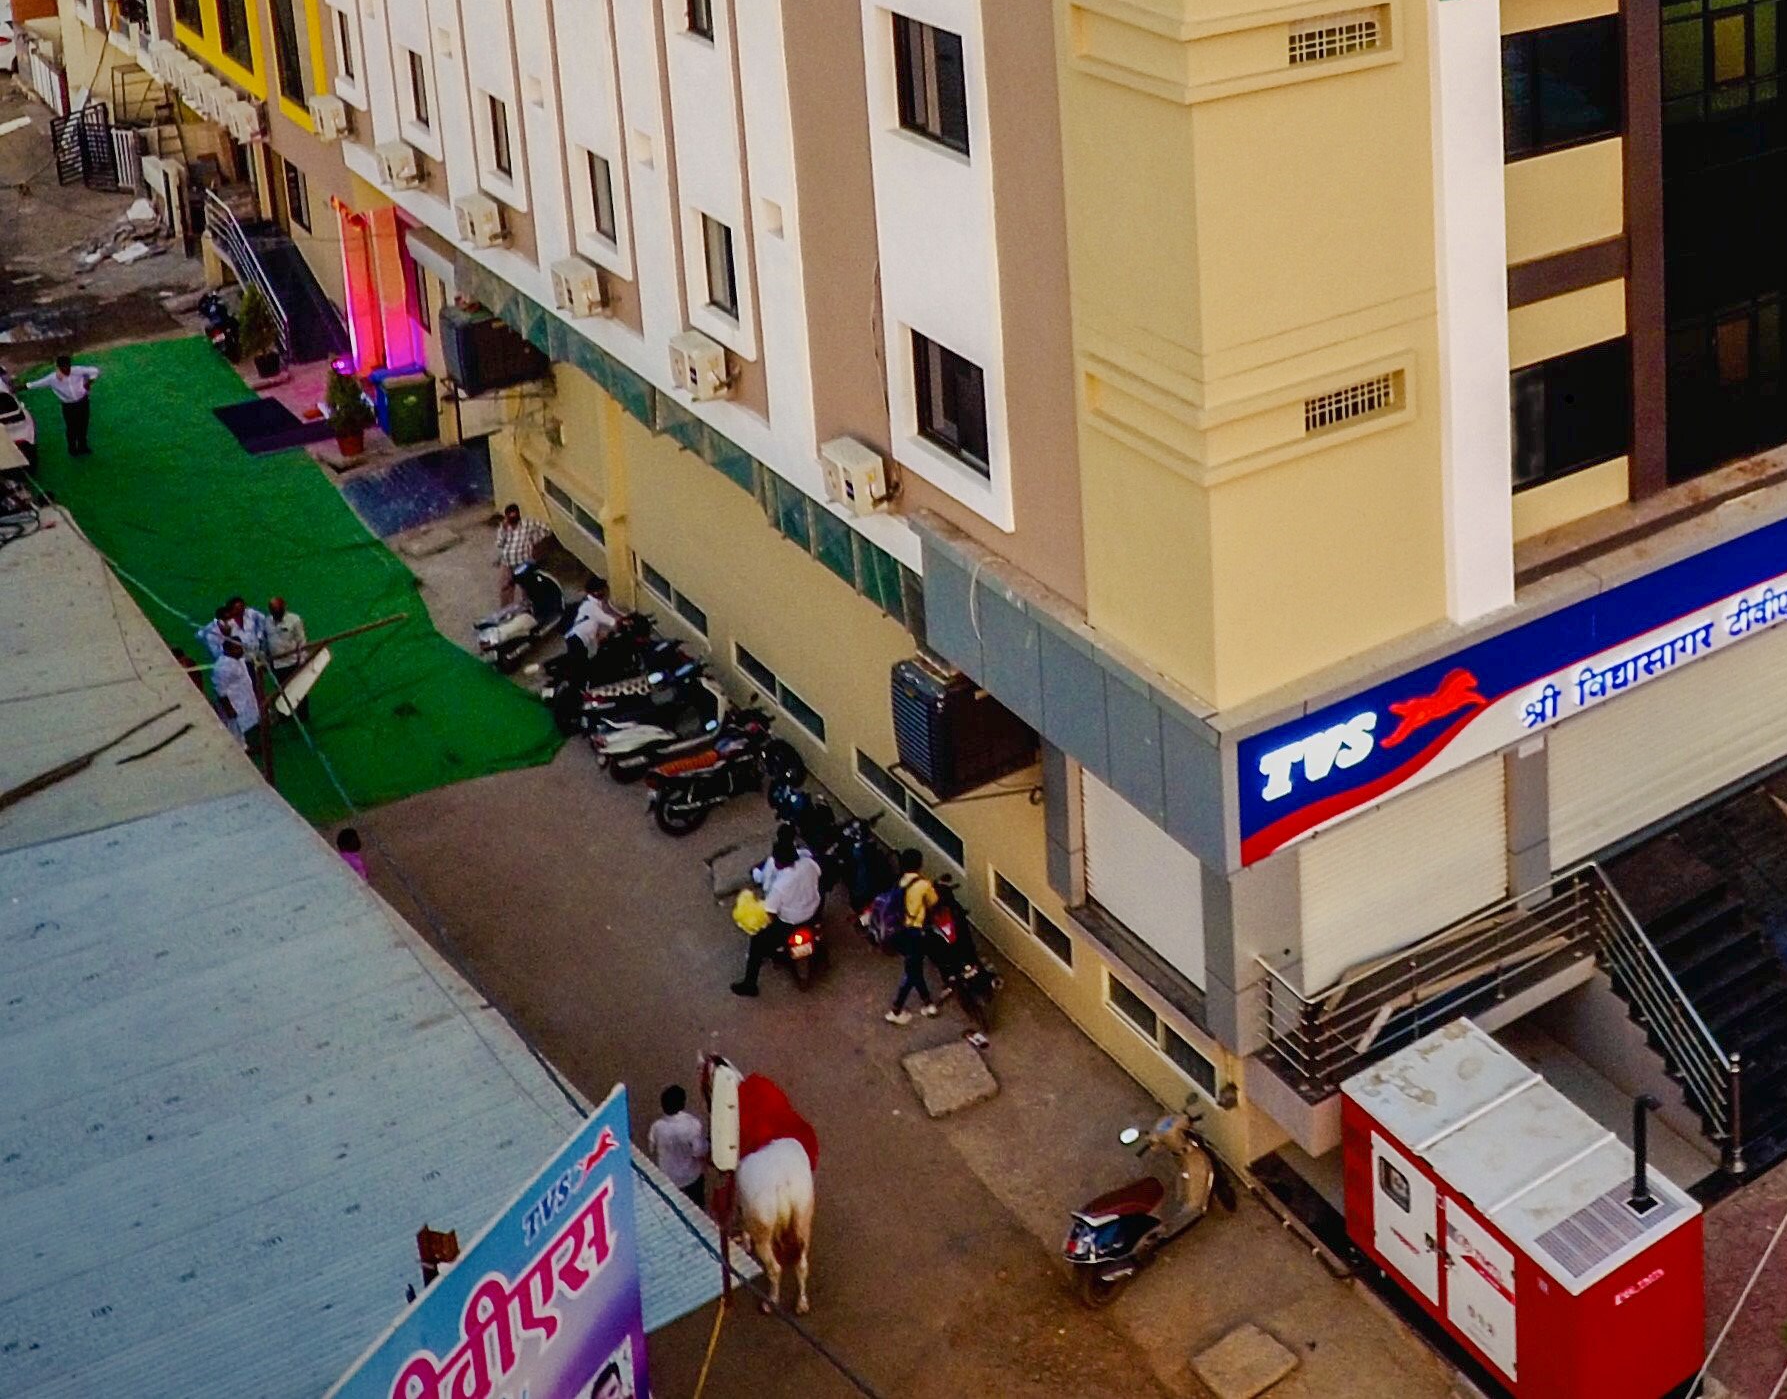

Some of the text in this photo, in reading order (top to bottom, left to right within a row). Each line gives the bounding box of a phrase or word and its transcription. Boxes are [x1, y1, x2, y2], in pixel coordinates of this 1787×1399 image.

[1521, 684, 1561, 728] श्री
[1573, 622, 1714, 705] विद्यासागर
[1259, 711, 1377, 801] TVS
[522, 1168, 571, 1245] TVS
